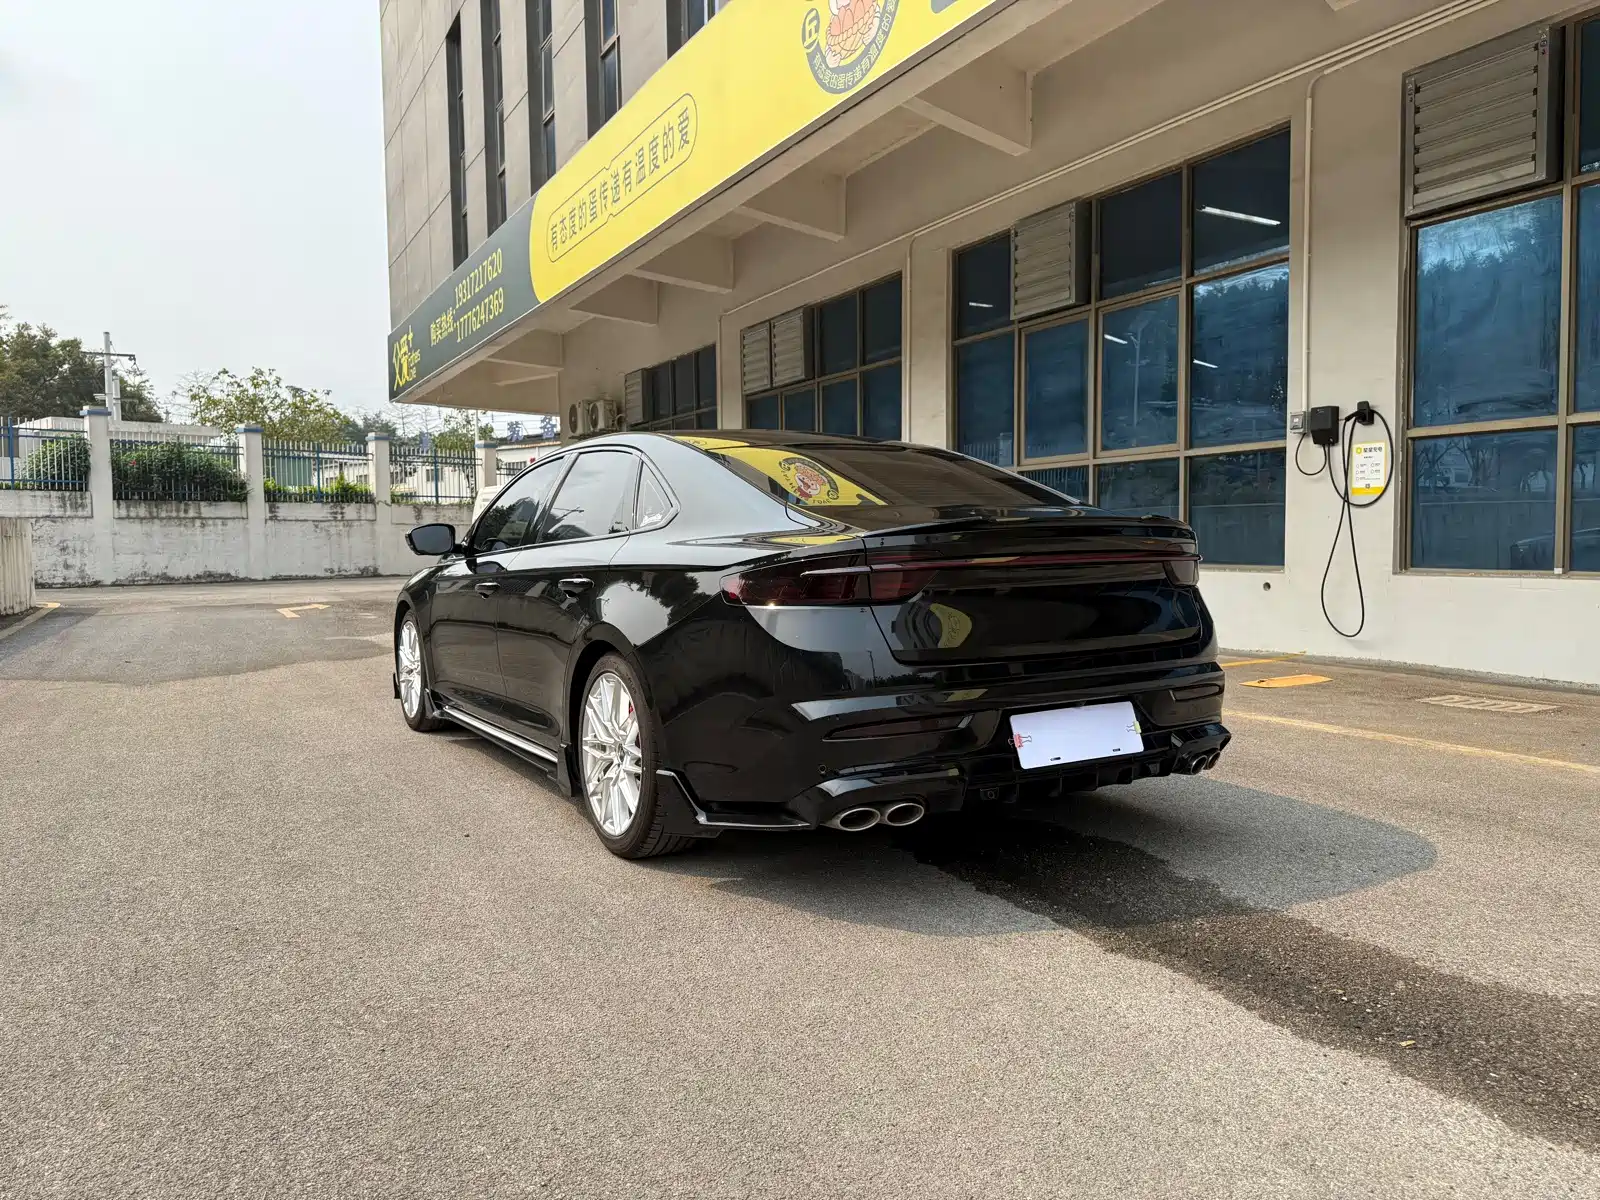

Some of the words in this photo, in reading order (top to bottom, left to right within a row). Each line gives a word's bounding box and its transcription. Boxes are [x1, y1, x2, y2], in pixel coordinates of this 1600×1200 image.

[550, 106, 690, 253] 有态度的蛋传递有温度的爱
[455, 247, 503, 309] 19317217620
[456, 287, 504, 343] 17776247369
